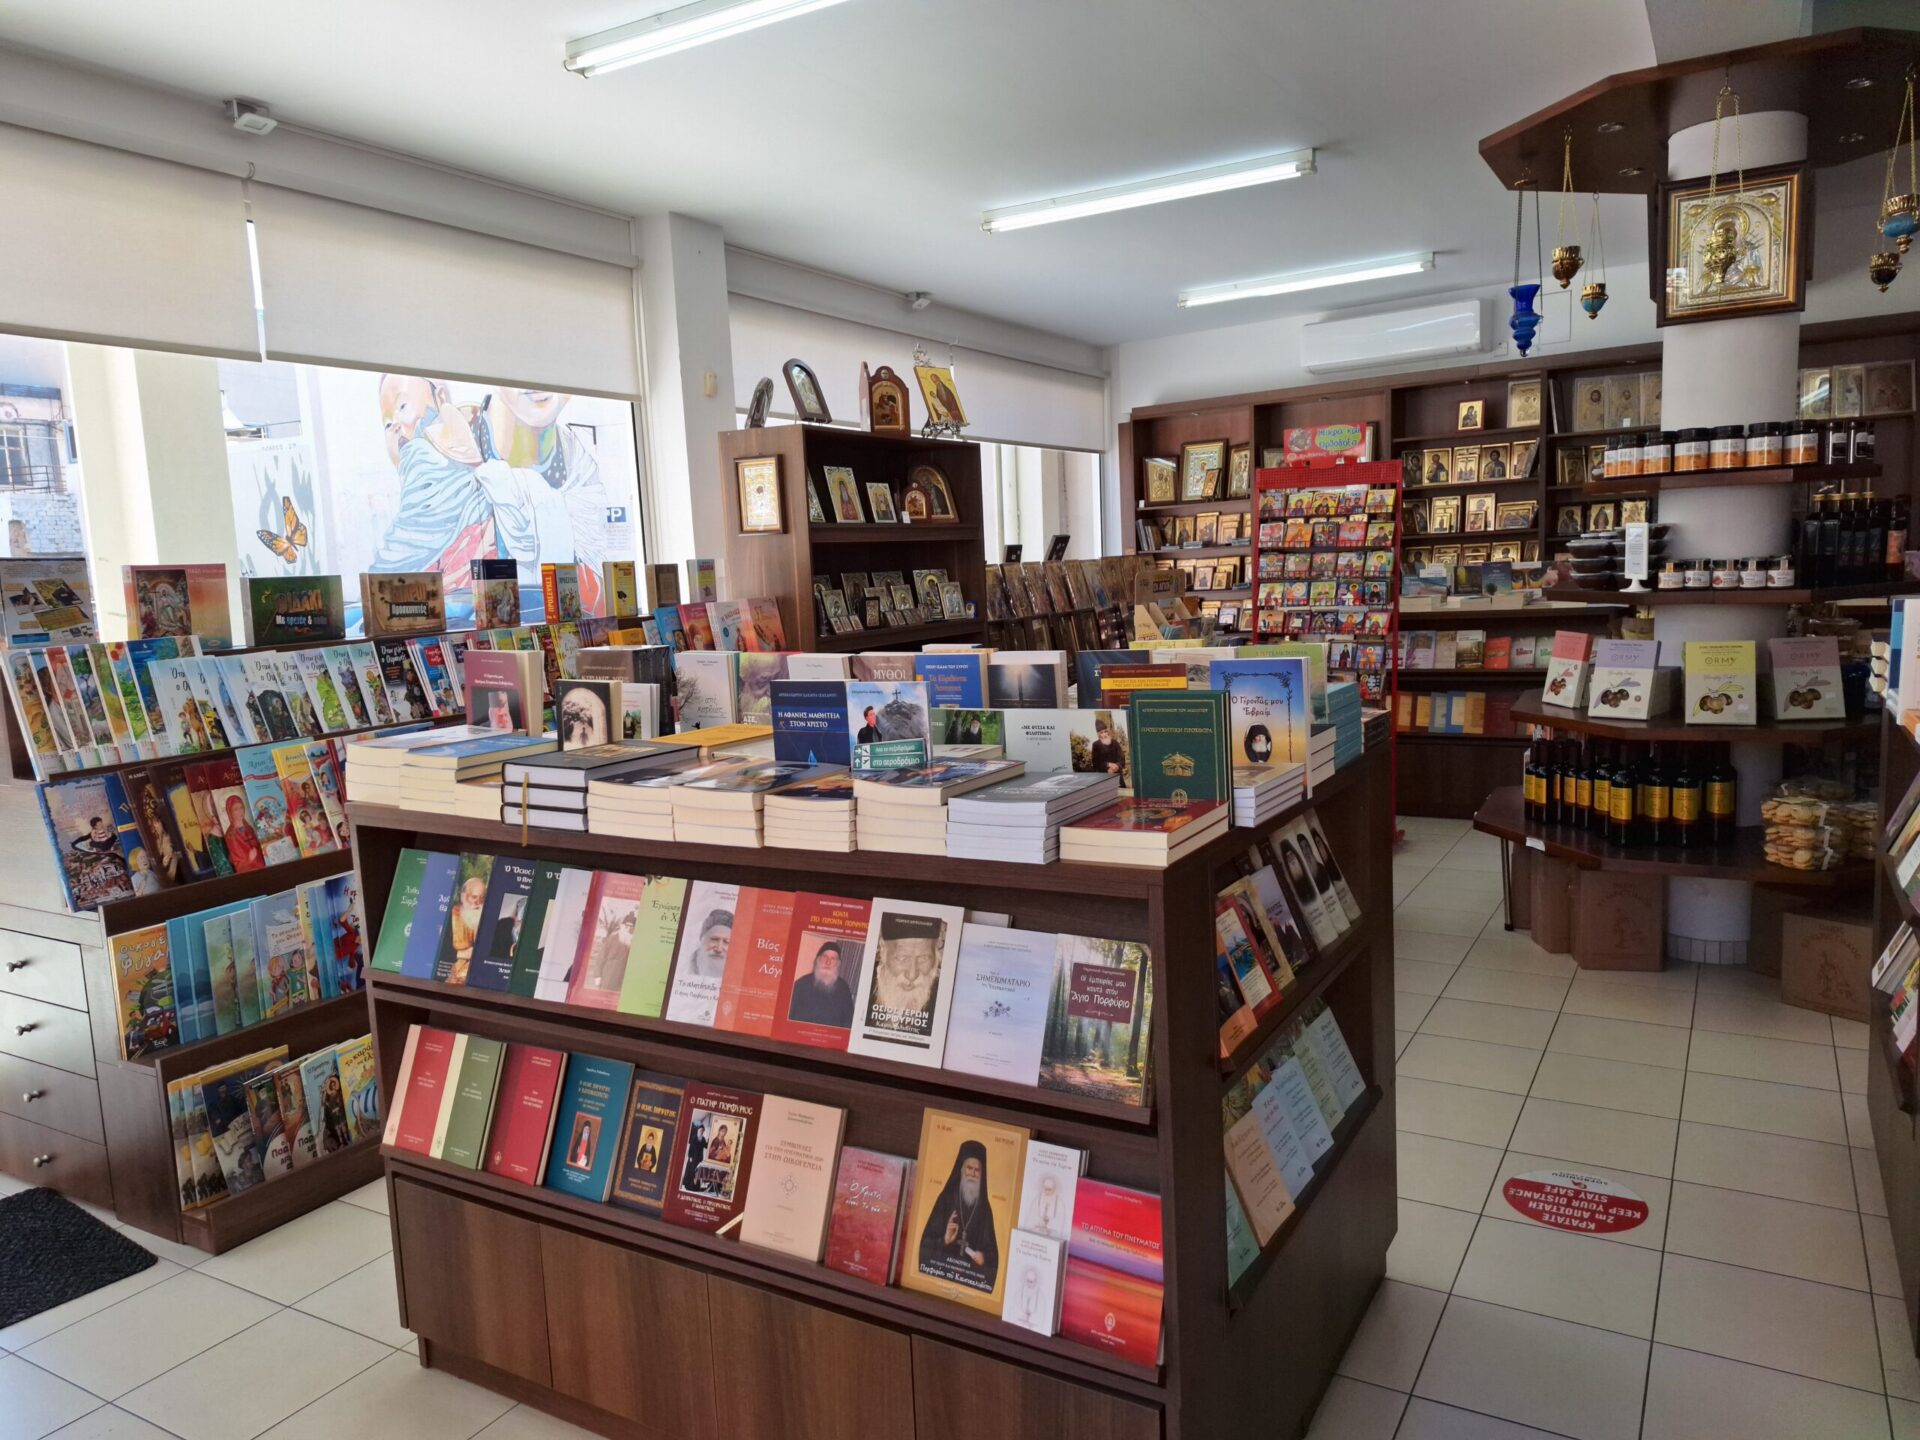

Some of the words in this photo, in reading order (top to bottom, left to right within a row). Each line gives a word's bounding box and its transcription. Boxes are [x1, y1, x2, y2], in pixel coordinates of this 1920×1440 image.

[1271, 698, 1284, 706] μου
[808, 712, 840, 720] ΜΑΘΗΤΕΙΑ
[789, 720, 806, 728] ΣΤΟΝ
[806, 720, 828, 728] ΧΡΙΣΤΟ
[883, 757, 920, 767] αεροδρόμιο
[872, 1003, 898, 1015] ΟΣΙΟΣ
[899, 1007, 929, 1019] ΓΕΡΩΝ
[871, 1011, 928, 1028] ΠΟΡΦΥΡΙΟΣ
[690, 1096, 695, 1104] Ο
[784, 1156, 822, 1172] ΟΙΚΟΓΕΝΕΙΑ
[1544, 1184, 1575, 1197] SAFE
[1578, 1191, 1608, 1203] STAY
[1528, 1201, 1591, 1219] ΑΠΟΣΤΑΣΗ
[1571, 1199, 1604, 1212] YOUR
[1595, 1213, 1615, 1224] 2m
[1608, 1208, 1641, 1219] KEEP
[1542, 1213, 1596, 1230] ΚΡΑΤΑΤΕ
[1112, 1230, 1124, 1240] ΤΟΥ
[1125, 1232, 1160, 1250] ΠΝΕΥΜΑΤΟΣ
